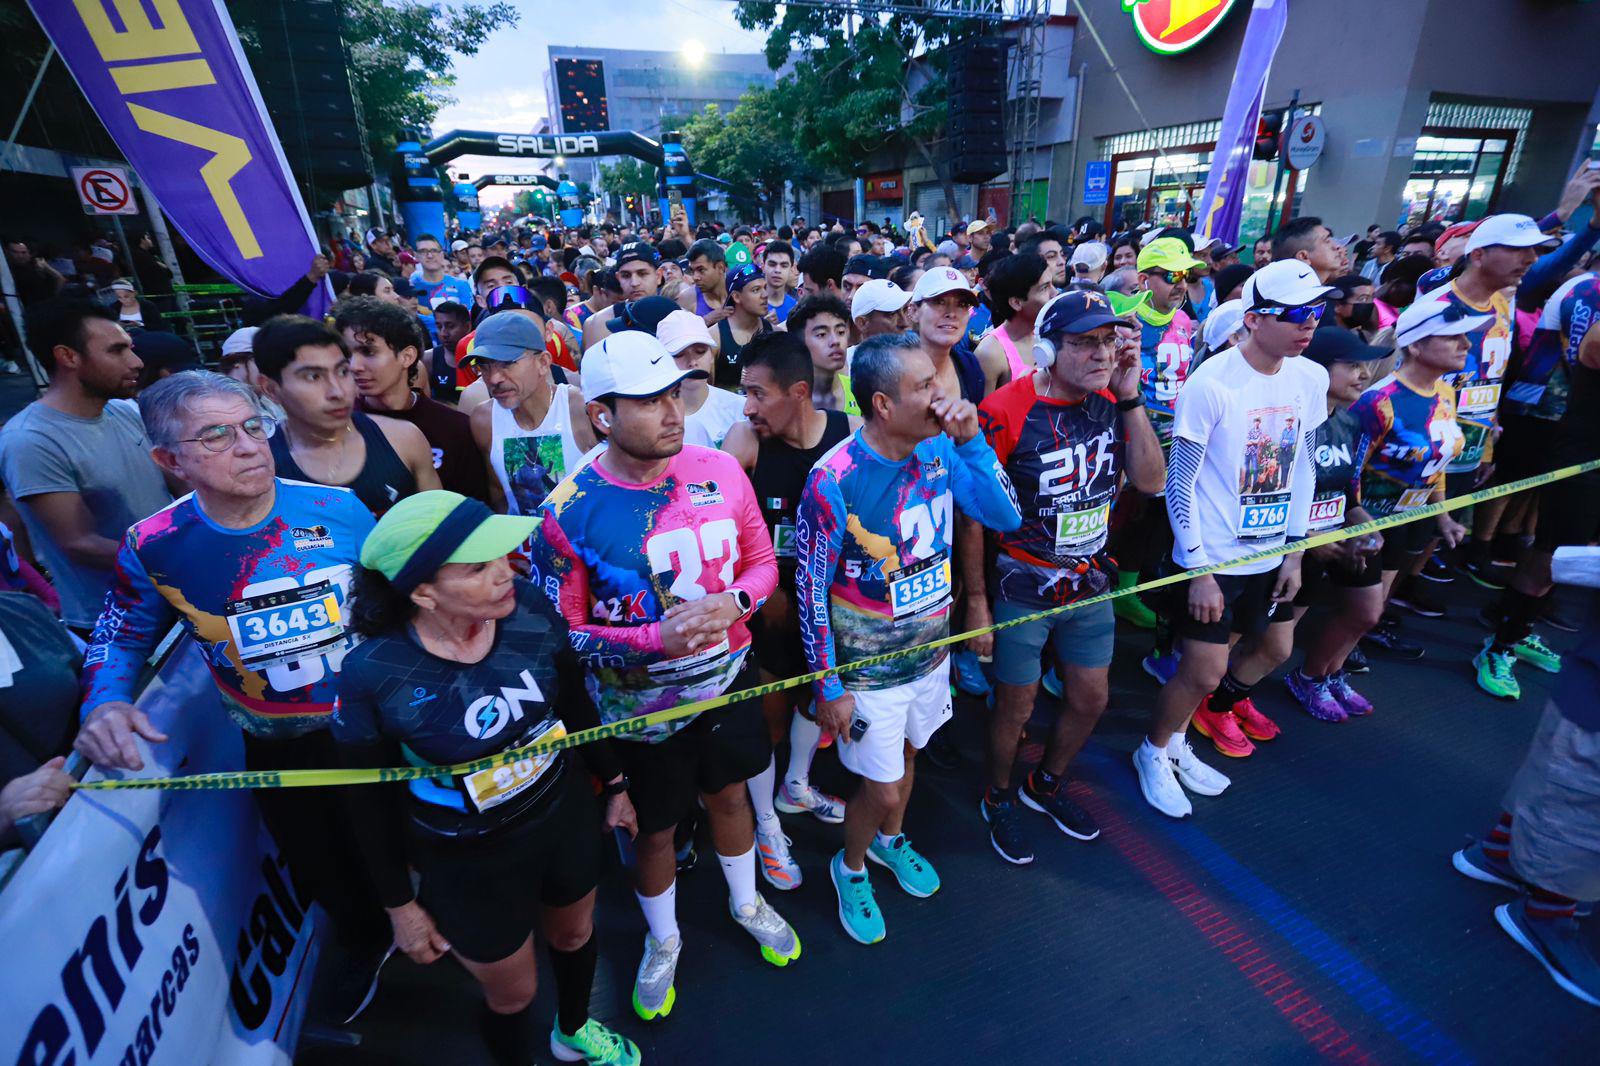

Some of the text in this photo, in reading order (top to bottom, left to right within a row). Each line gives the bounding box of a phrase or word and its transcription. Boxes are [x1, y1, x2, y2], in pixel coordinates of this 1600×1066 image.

[496, 134, 599, 154] SALIDA
[494, 175, 539, 185] SALIDA
[1314, 443, 1352, 467] ON
[1247, 506, 1285, 526] 3766
[844, 556, 889, 581] 5K
[899, 566, 946, 603] 3535
[592, 590, 648, 623] 42K
[245, 603, 329, 641] 3643
[264, 637, 300, 649] DISTANCIA
[463, 669, 545, 740] ON
